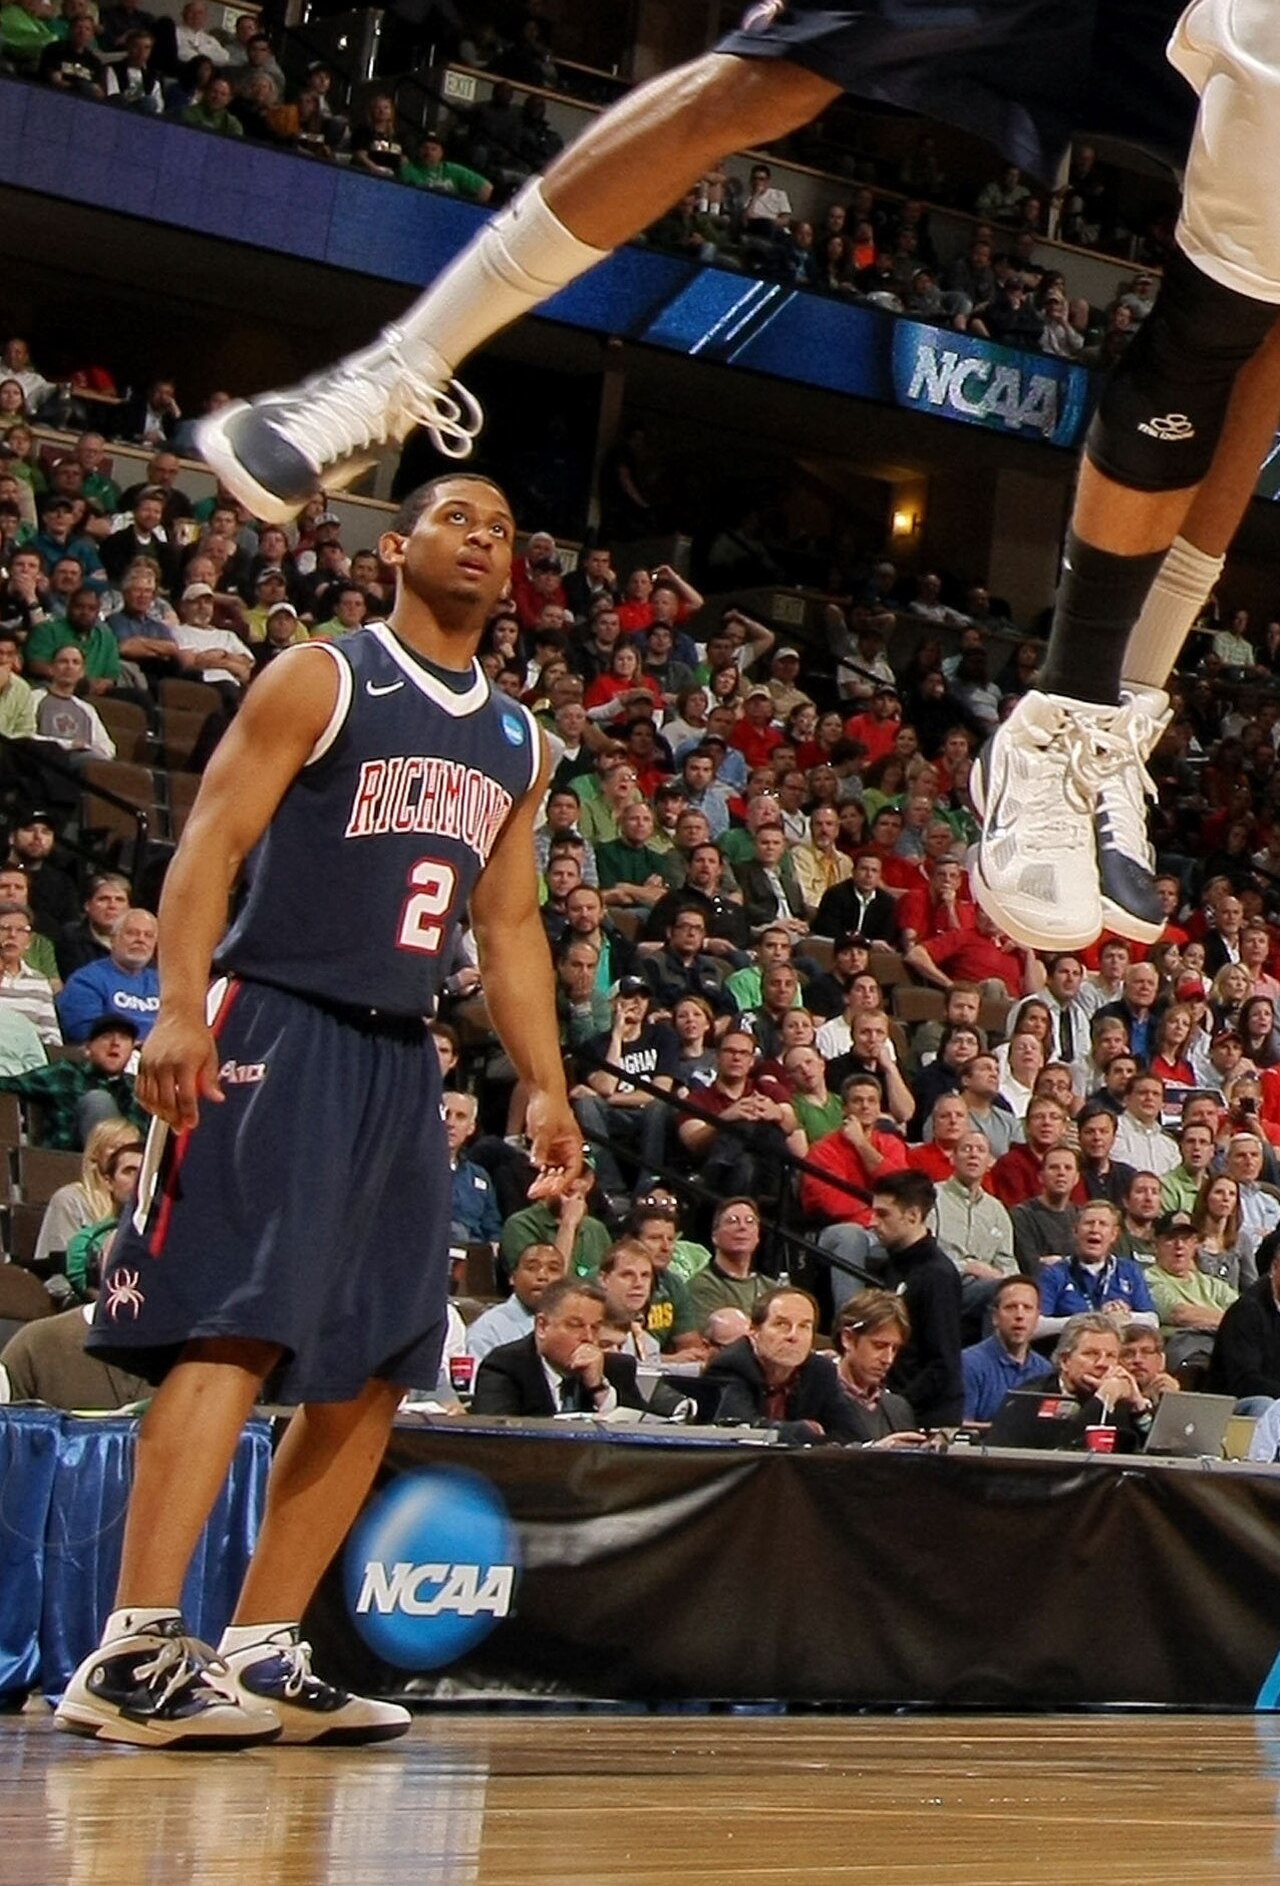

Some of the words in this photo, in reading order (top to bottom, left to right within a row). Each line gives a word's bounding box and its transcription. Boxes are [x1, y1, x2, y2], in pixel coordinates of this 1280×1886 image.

[446, 73, 473, 99] EXIT
[907, 345, 1058, 438] NCAA
[396, 858, 458, 954] 2
[356, 1562, 514, 1617] NCAA
